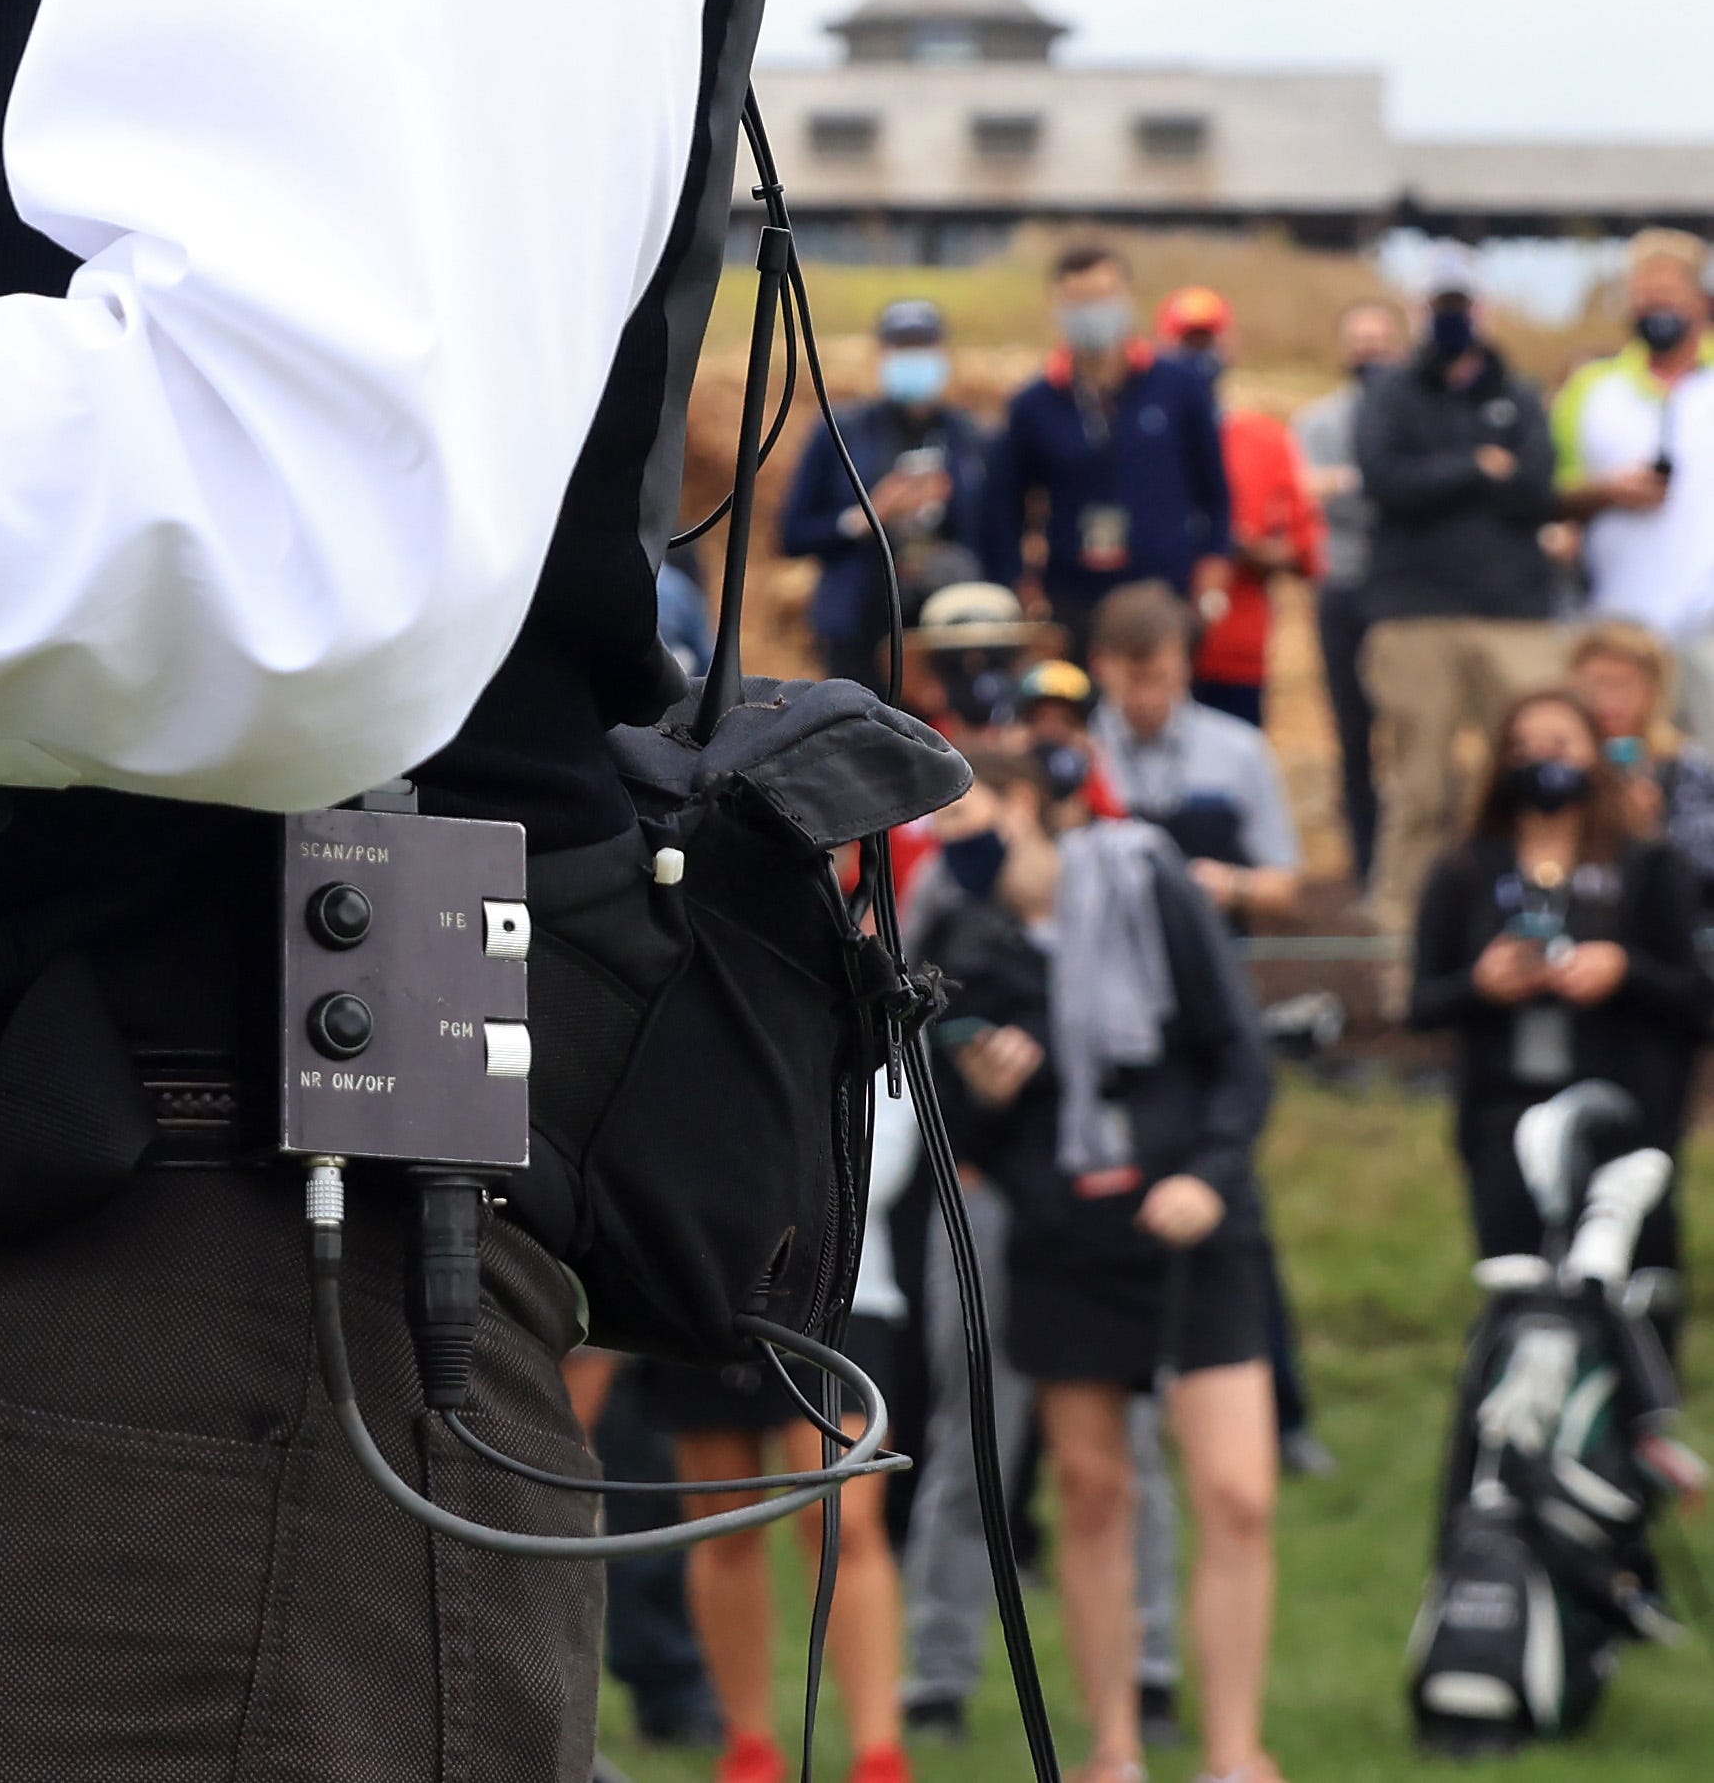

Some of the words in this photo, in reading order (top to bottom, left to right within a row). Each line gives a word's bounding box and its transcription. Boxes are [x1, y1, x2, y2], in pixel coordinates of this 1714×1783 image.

[300, 841, 389, 863] SCAN/PGM
[439, 1022, 473, 1038] PGM
[300, 1072, 321, 1089] NR
[332, 1073, 396, 1094] ON/OFF
